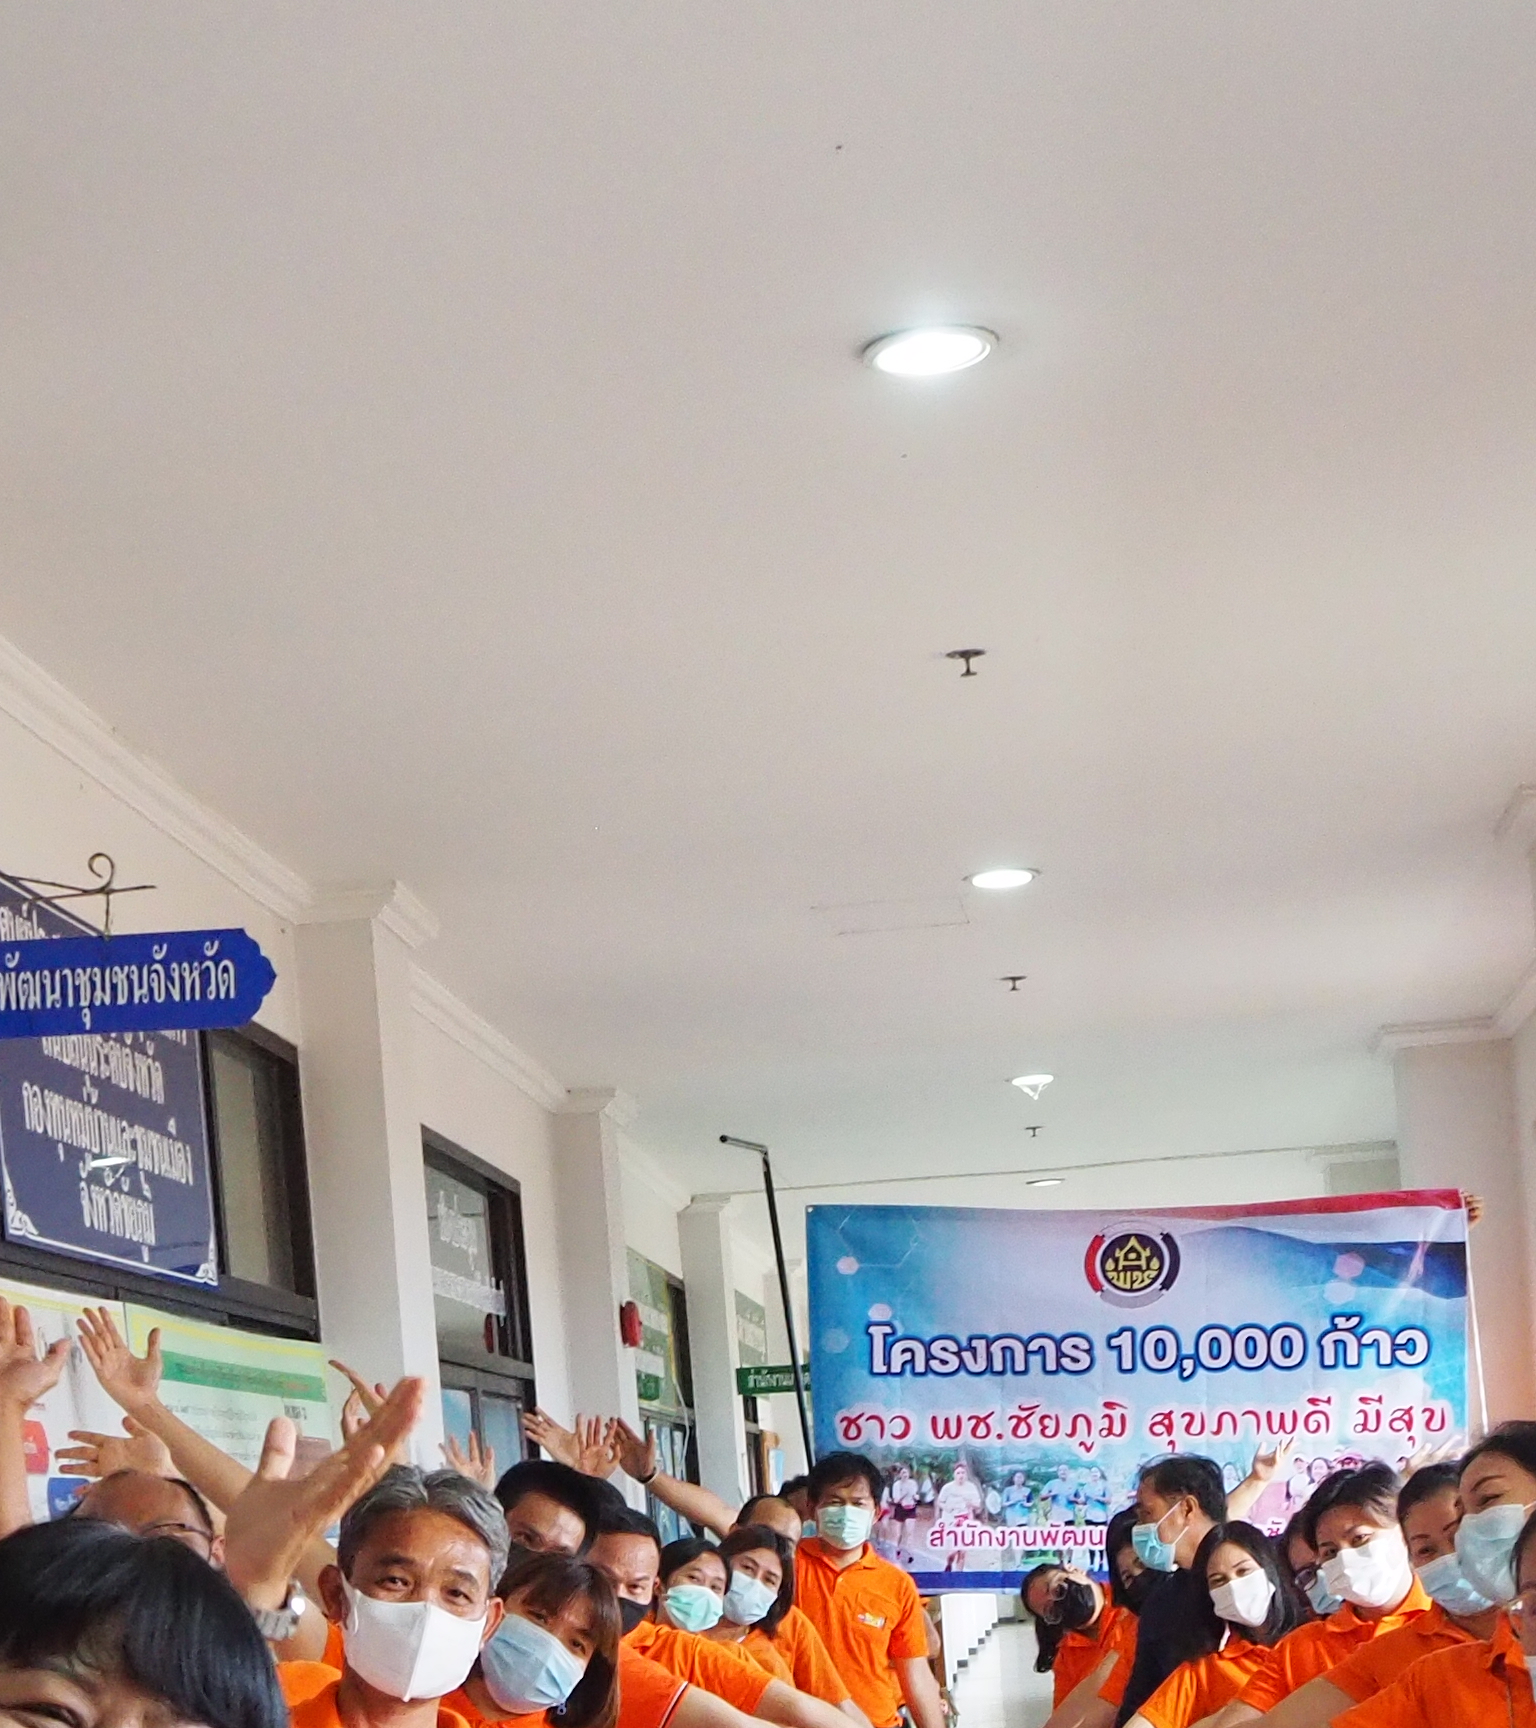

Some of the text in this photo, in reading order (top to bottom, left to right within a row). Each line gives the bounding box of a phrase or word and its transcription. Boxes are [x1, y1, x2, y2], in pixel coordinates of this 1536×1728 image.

[867, 1316, 1429, 1379] โครงการ 10,000 ก้าว
[838, 1394, 1448, 1453] ชาว พช.ชัยภูมิ สุขภาพดี มีสุข
[930, 1521, 1107, 1549] สำนักงานพัฒน
